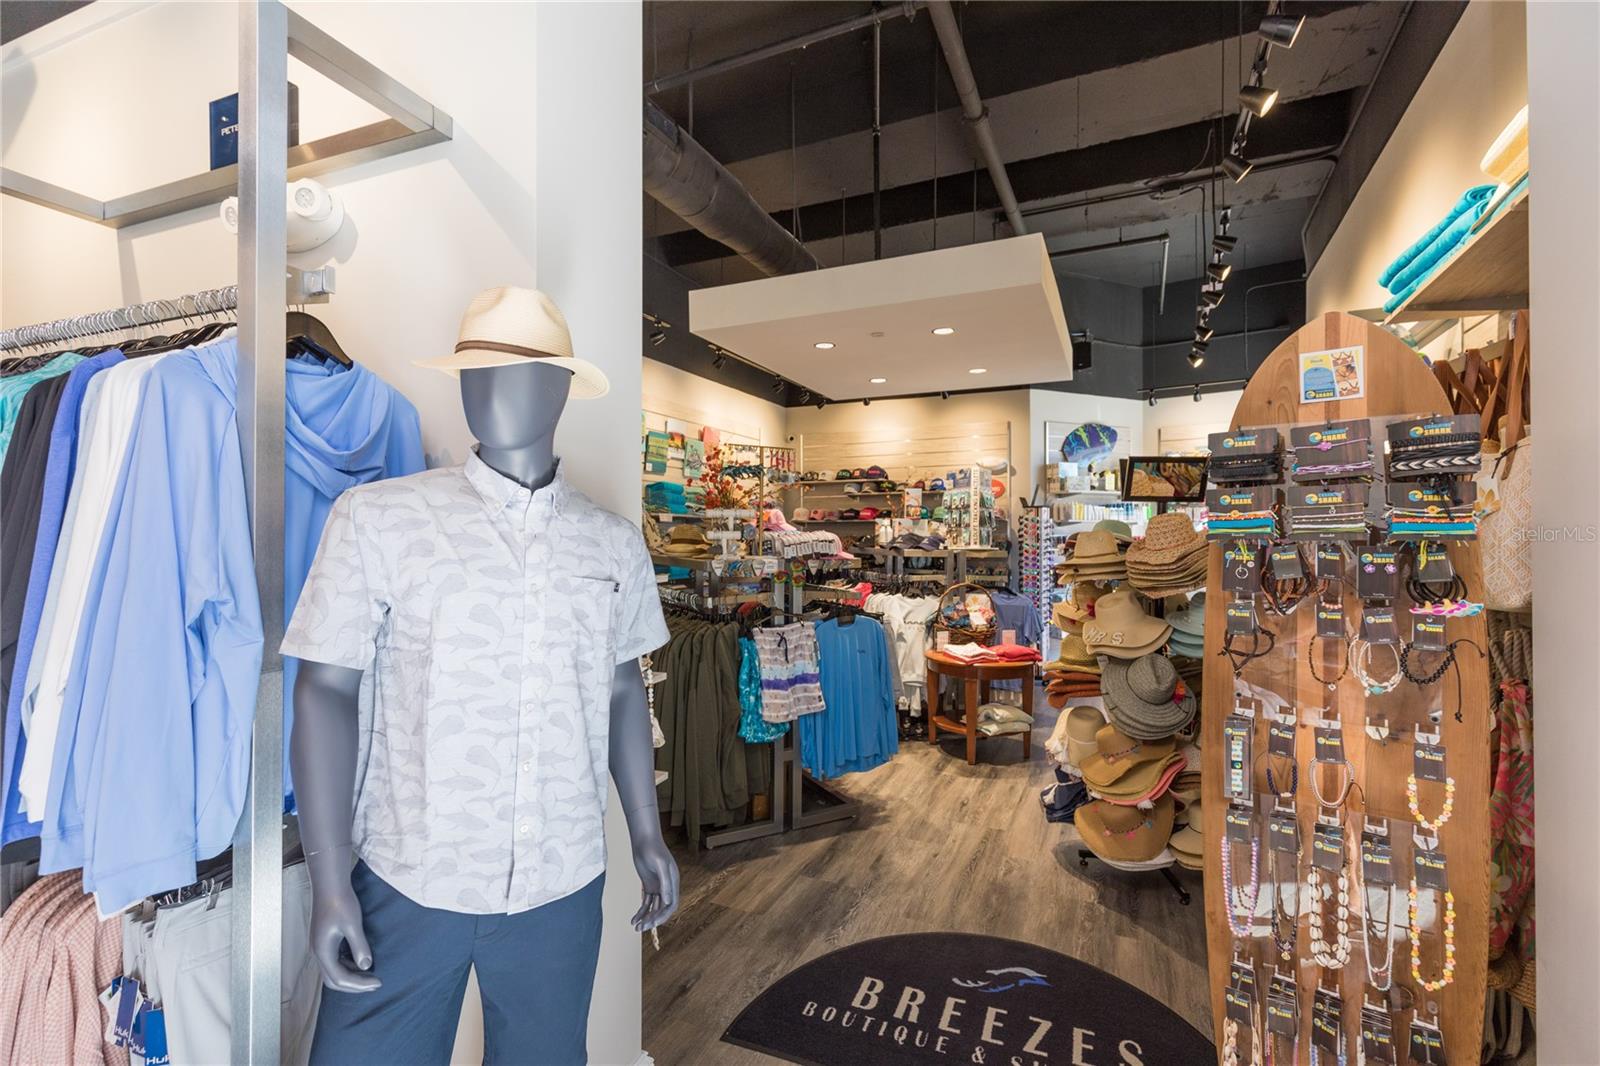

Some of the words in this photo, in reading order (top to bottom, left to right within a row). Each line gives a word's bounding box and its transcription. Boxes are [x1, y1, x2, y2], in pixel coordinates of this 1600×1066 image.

[1424, 427, 1452, 436] SHARK
[1322, 432, 1347, 441] SHARK
[1231, 497, 1252, 505] SHARK
[1318, 496, 1344, 504] SHARK
[851, 976, 1146, 1066] BREEZES
[802, 1001, 950, 1054] BOUTIQUE
[971, 1045, 986, 1064] &
